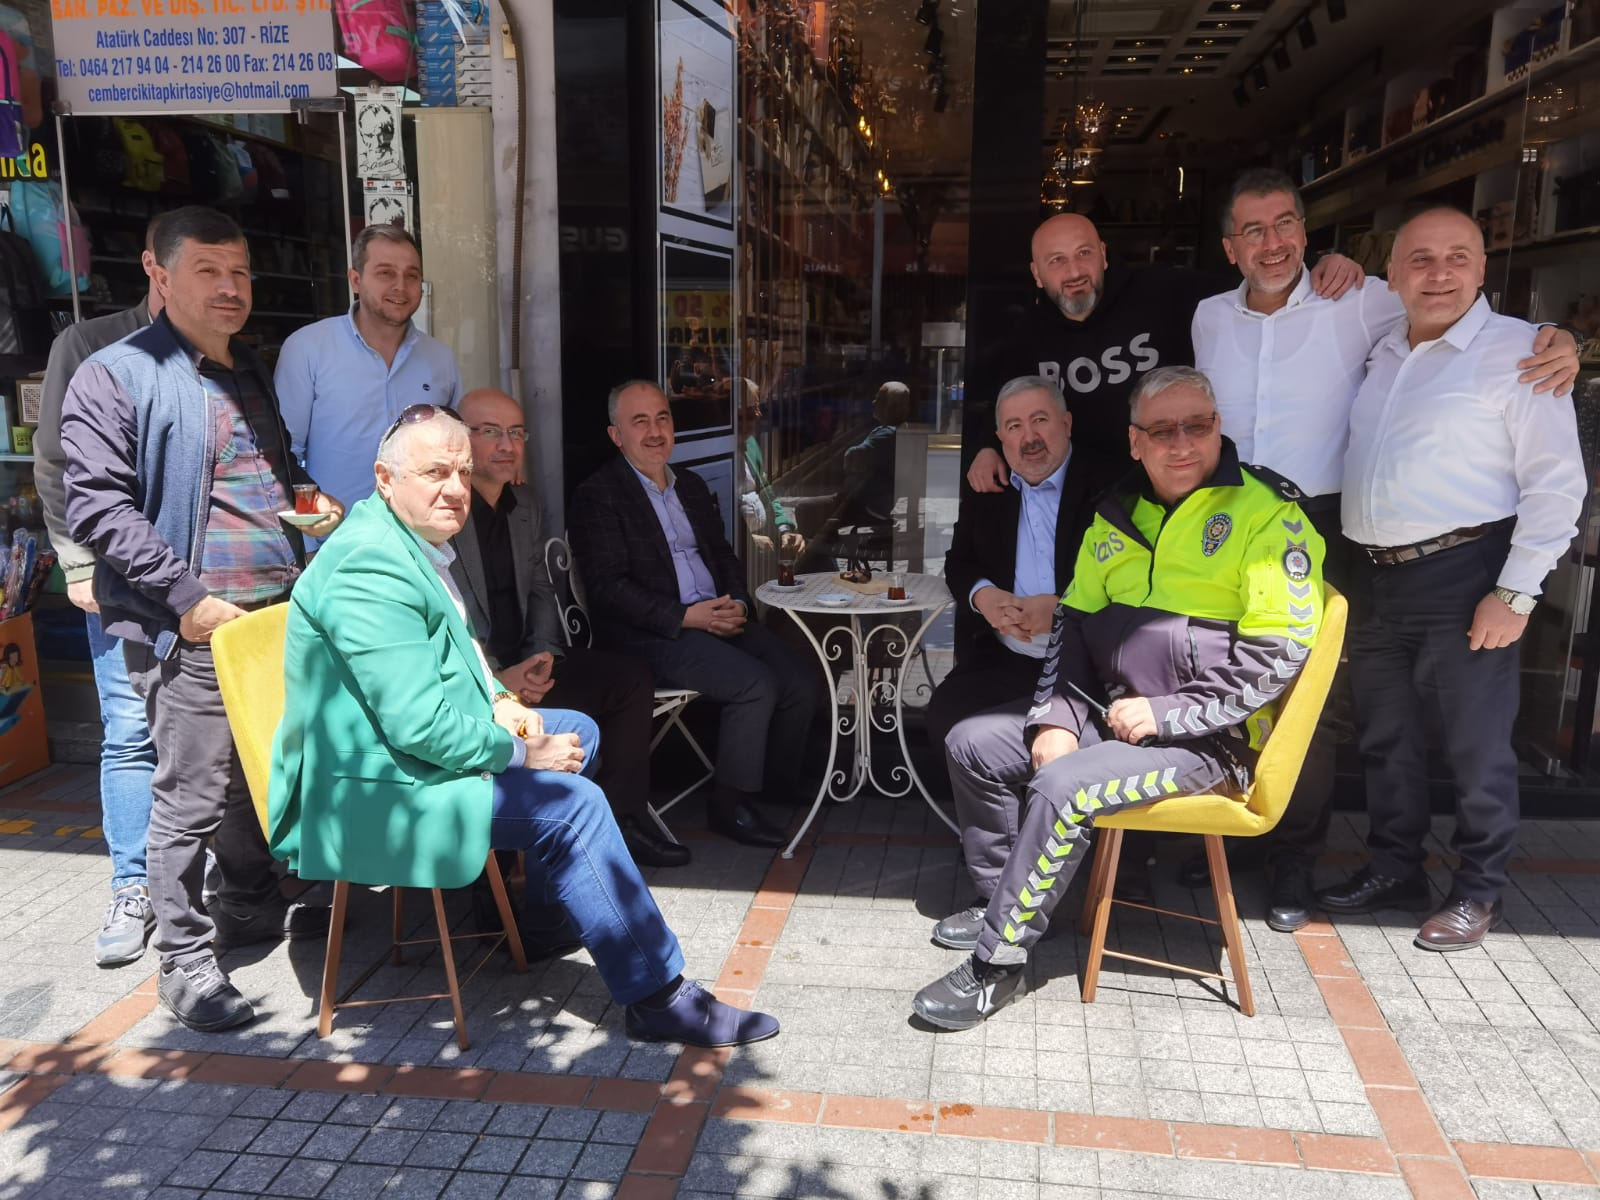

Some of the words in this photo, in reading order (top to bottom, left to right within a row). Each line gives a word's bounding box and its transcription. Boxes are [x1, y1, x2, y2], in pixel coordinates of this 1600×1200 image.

[141, 0, 164, 16] VE
[96, 29, 140, 48] Atatürk
[197, 27, 218, 45] No:
[222, 26, 245, 45] 307
[259, 21, 289, 44] RİZE
[56, 58, 76, 78] Tel:
[80, 57, 108, 76] 0464
[111, 57, 132, 75] 217
[136, 56, 151, 75] 94
[154, 56, 169, 74] 04
[181, 55, 203, 73] 214
[207, 54, 221, 73] 26
[225, 54, 240, 73] 00
[244, 54, 268, 72] Fax:
[272, 53, 295, 71] 214
[299, 52, 314, 71] 26
[317, 52, 333, 71] 03
[88, 80, 310, 104] cembercikitapkirtasiye@hotmail.com
[1038, 332, 1159, 393] BOSS
